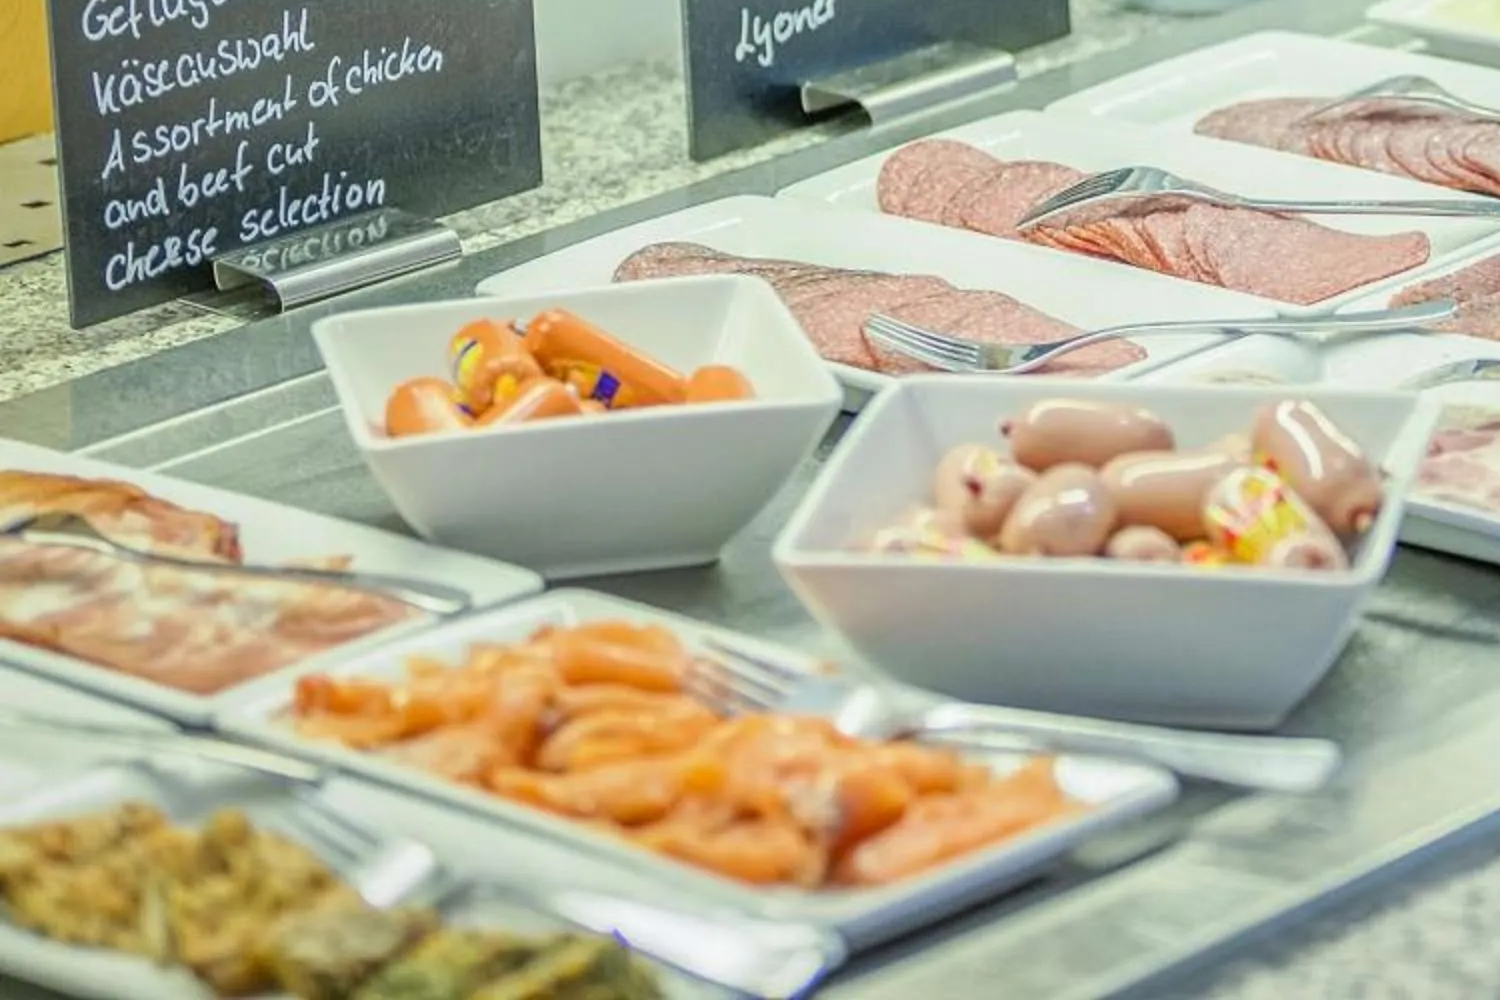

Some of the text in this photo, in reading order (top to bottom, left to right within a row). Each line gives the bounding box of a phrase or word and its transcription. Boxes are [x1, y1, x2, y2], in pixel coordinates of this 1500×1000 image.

[101, 36, 443, 179] Assortment of chicken
[104, 121, 319, 229] and beef cut
[239, 171, 385, 241] selection
